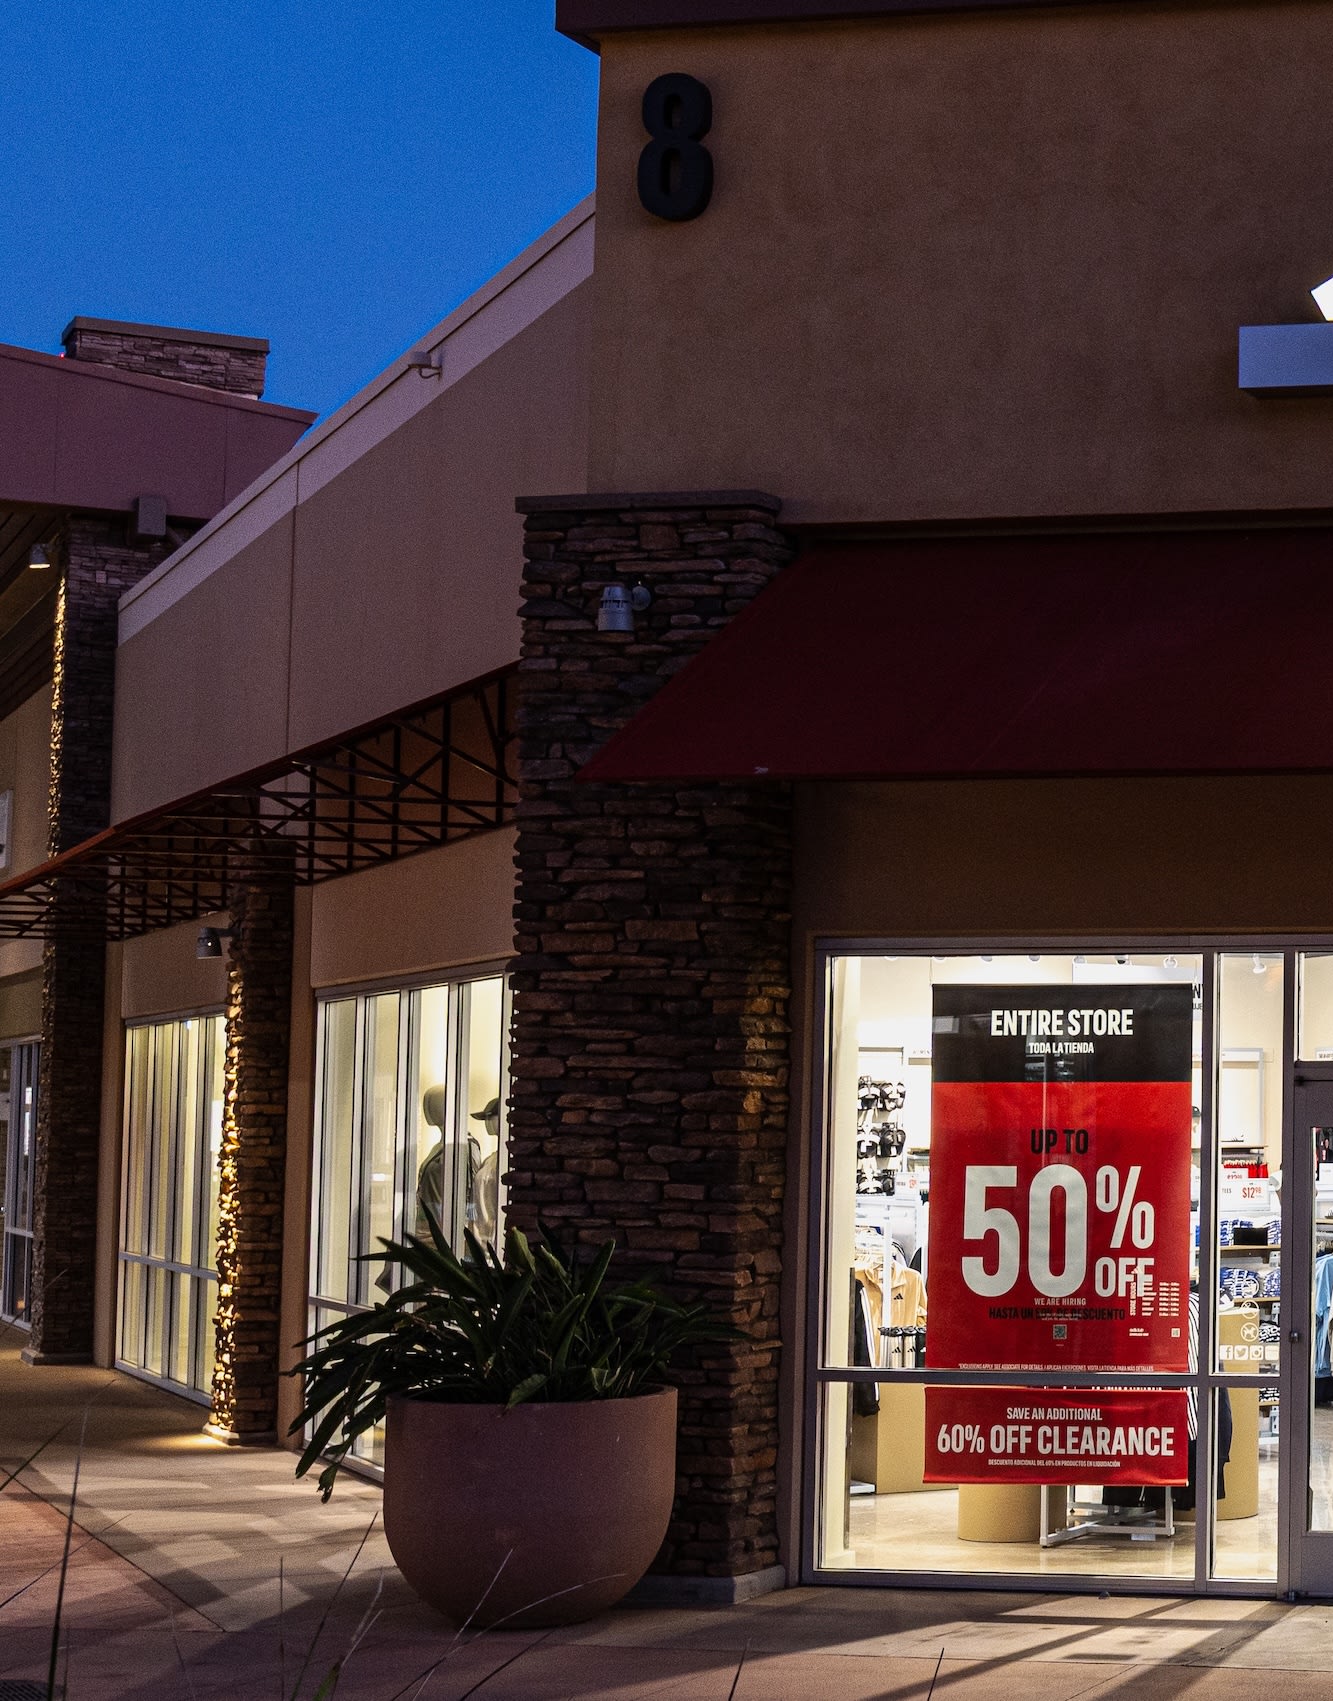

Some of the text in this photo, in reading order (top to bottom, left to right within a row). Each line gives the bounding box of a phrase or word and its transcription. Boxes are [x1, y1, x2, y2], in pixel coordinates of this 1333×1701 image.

[637, 72, 714, 222] 8
[991, 1009, 1133, 1036] ENTIRE STORE
[1029, 1042, 1094, 1054] TODA LA TIENDA
[1030, 1129, 1089, 1155] UP TO
[961, 1163, 1155, 1298] 50%
[1095, 1256, 1155, 1298] OFF
[988, 1307, 1019, 1319] HASTA
[1034, 1297, 1087, 1306] WE ARE HIRING
[1007, 1407, 1102, 1421] SAVE AN ADDITIONAL
[937, 1424, 1175, 1456] 60% OFF CLEARANCE
